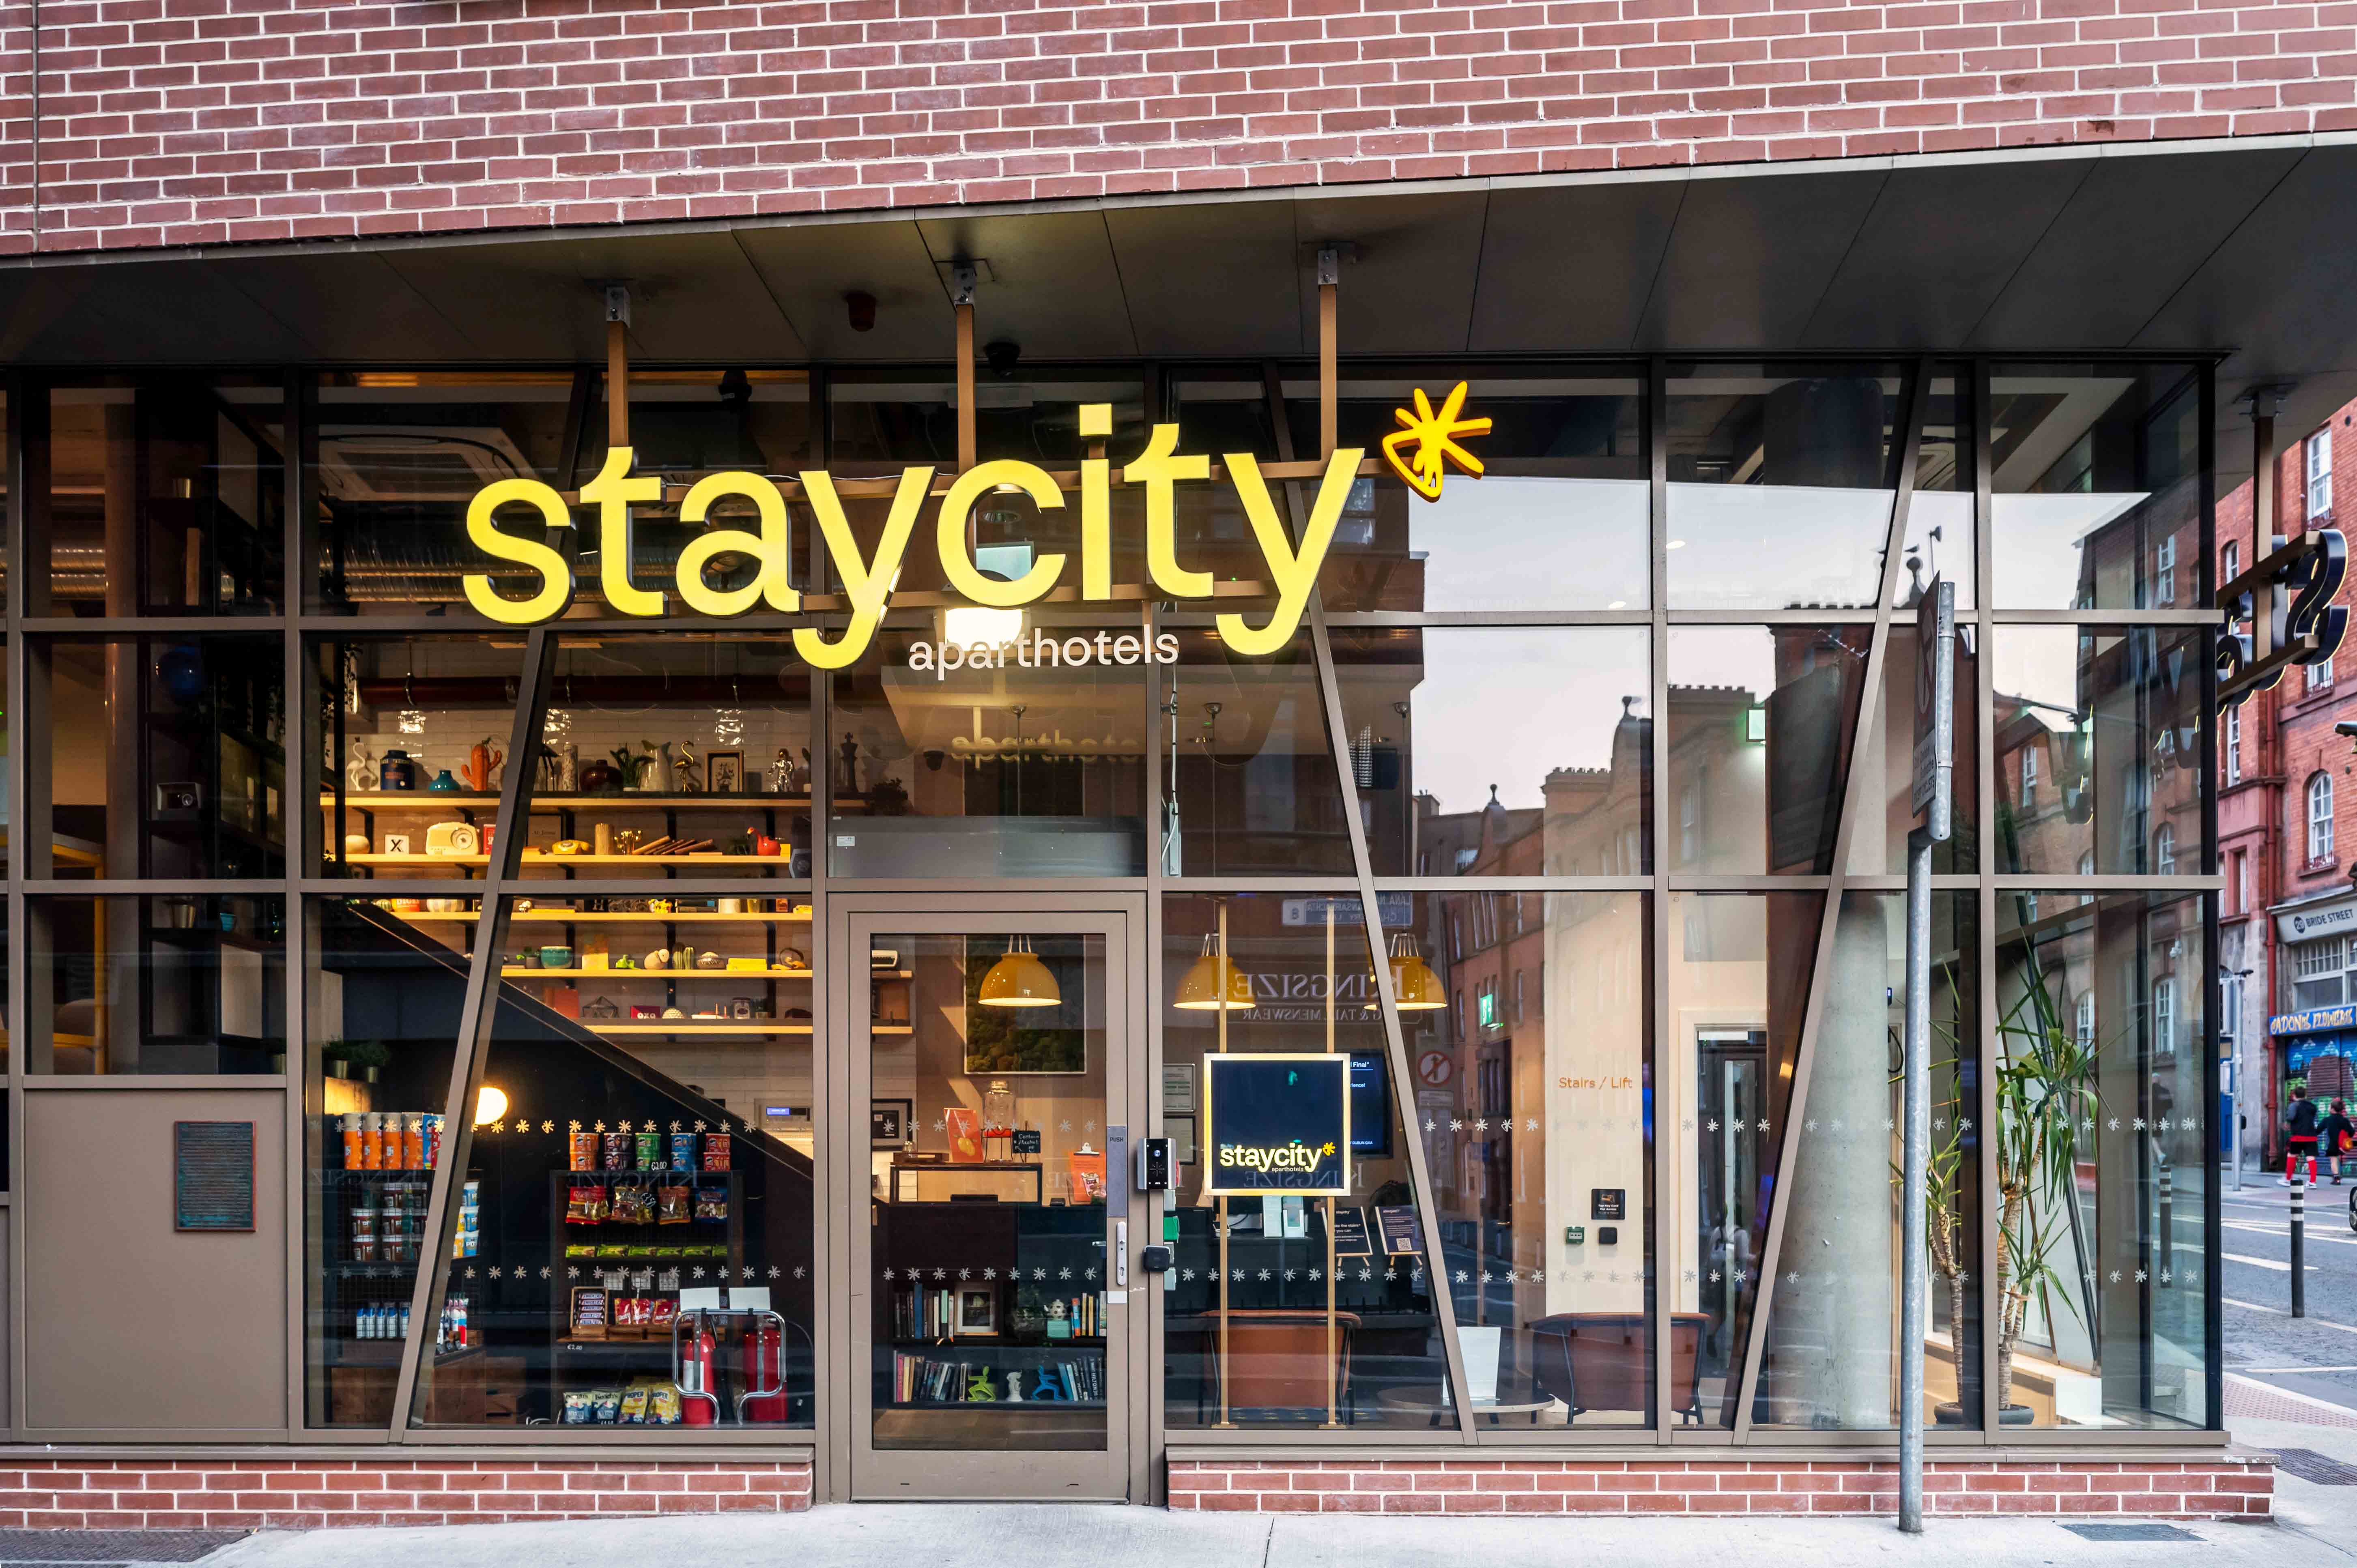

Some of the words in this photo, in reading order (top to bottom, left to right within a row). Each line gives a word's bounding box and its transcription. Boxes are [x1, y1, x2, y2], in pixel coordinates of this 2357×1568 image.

[463, 404, 1363, 668] staycity
[909, 624, 1178, 680] aparthotels
[2305, 915, 2327, 927] BRIDE
[2327, 908, 2353, 923] STREET
[1559, 1077, 1596, 1089] Stairs
[1598, 1076, 1607, 1090] /
[1611, 1077, 1633, 1089] Lift
[1220, 1143, 1323, 1172] staycity
